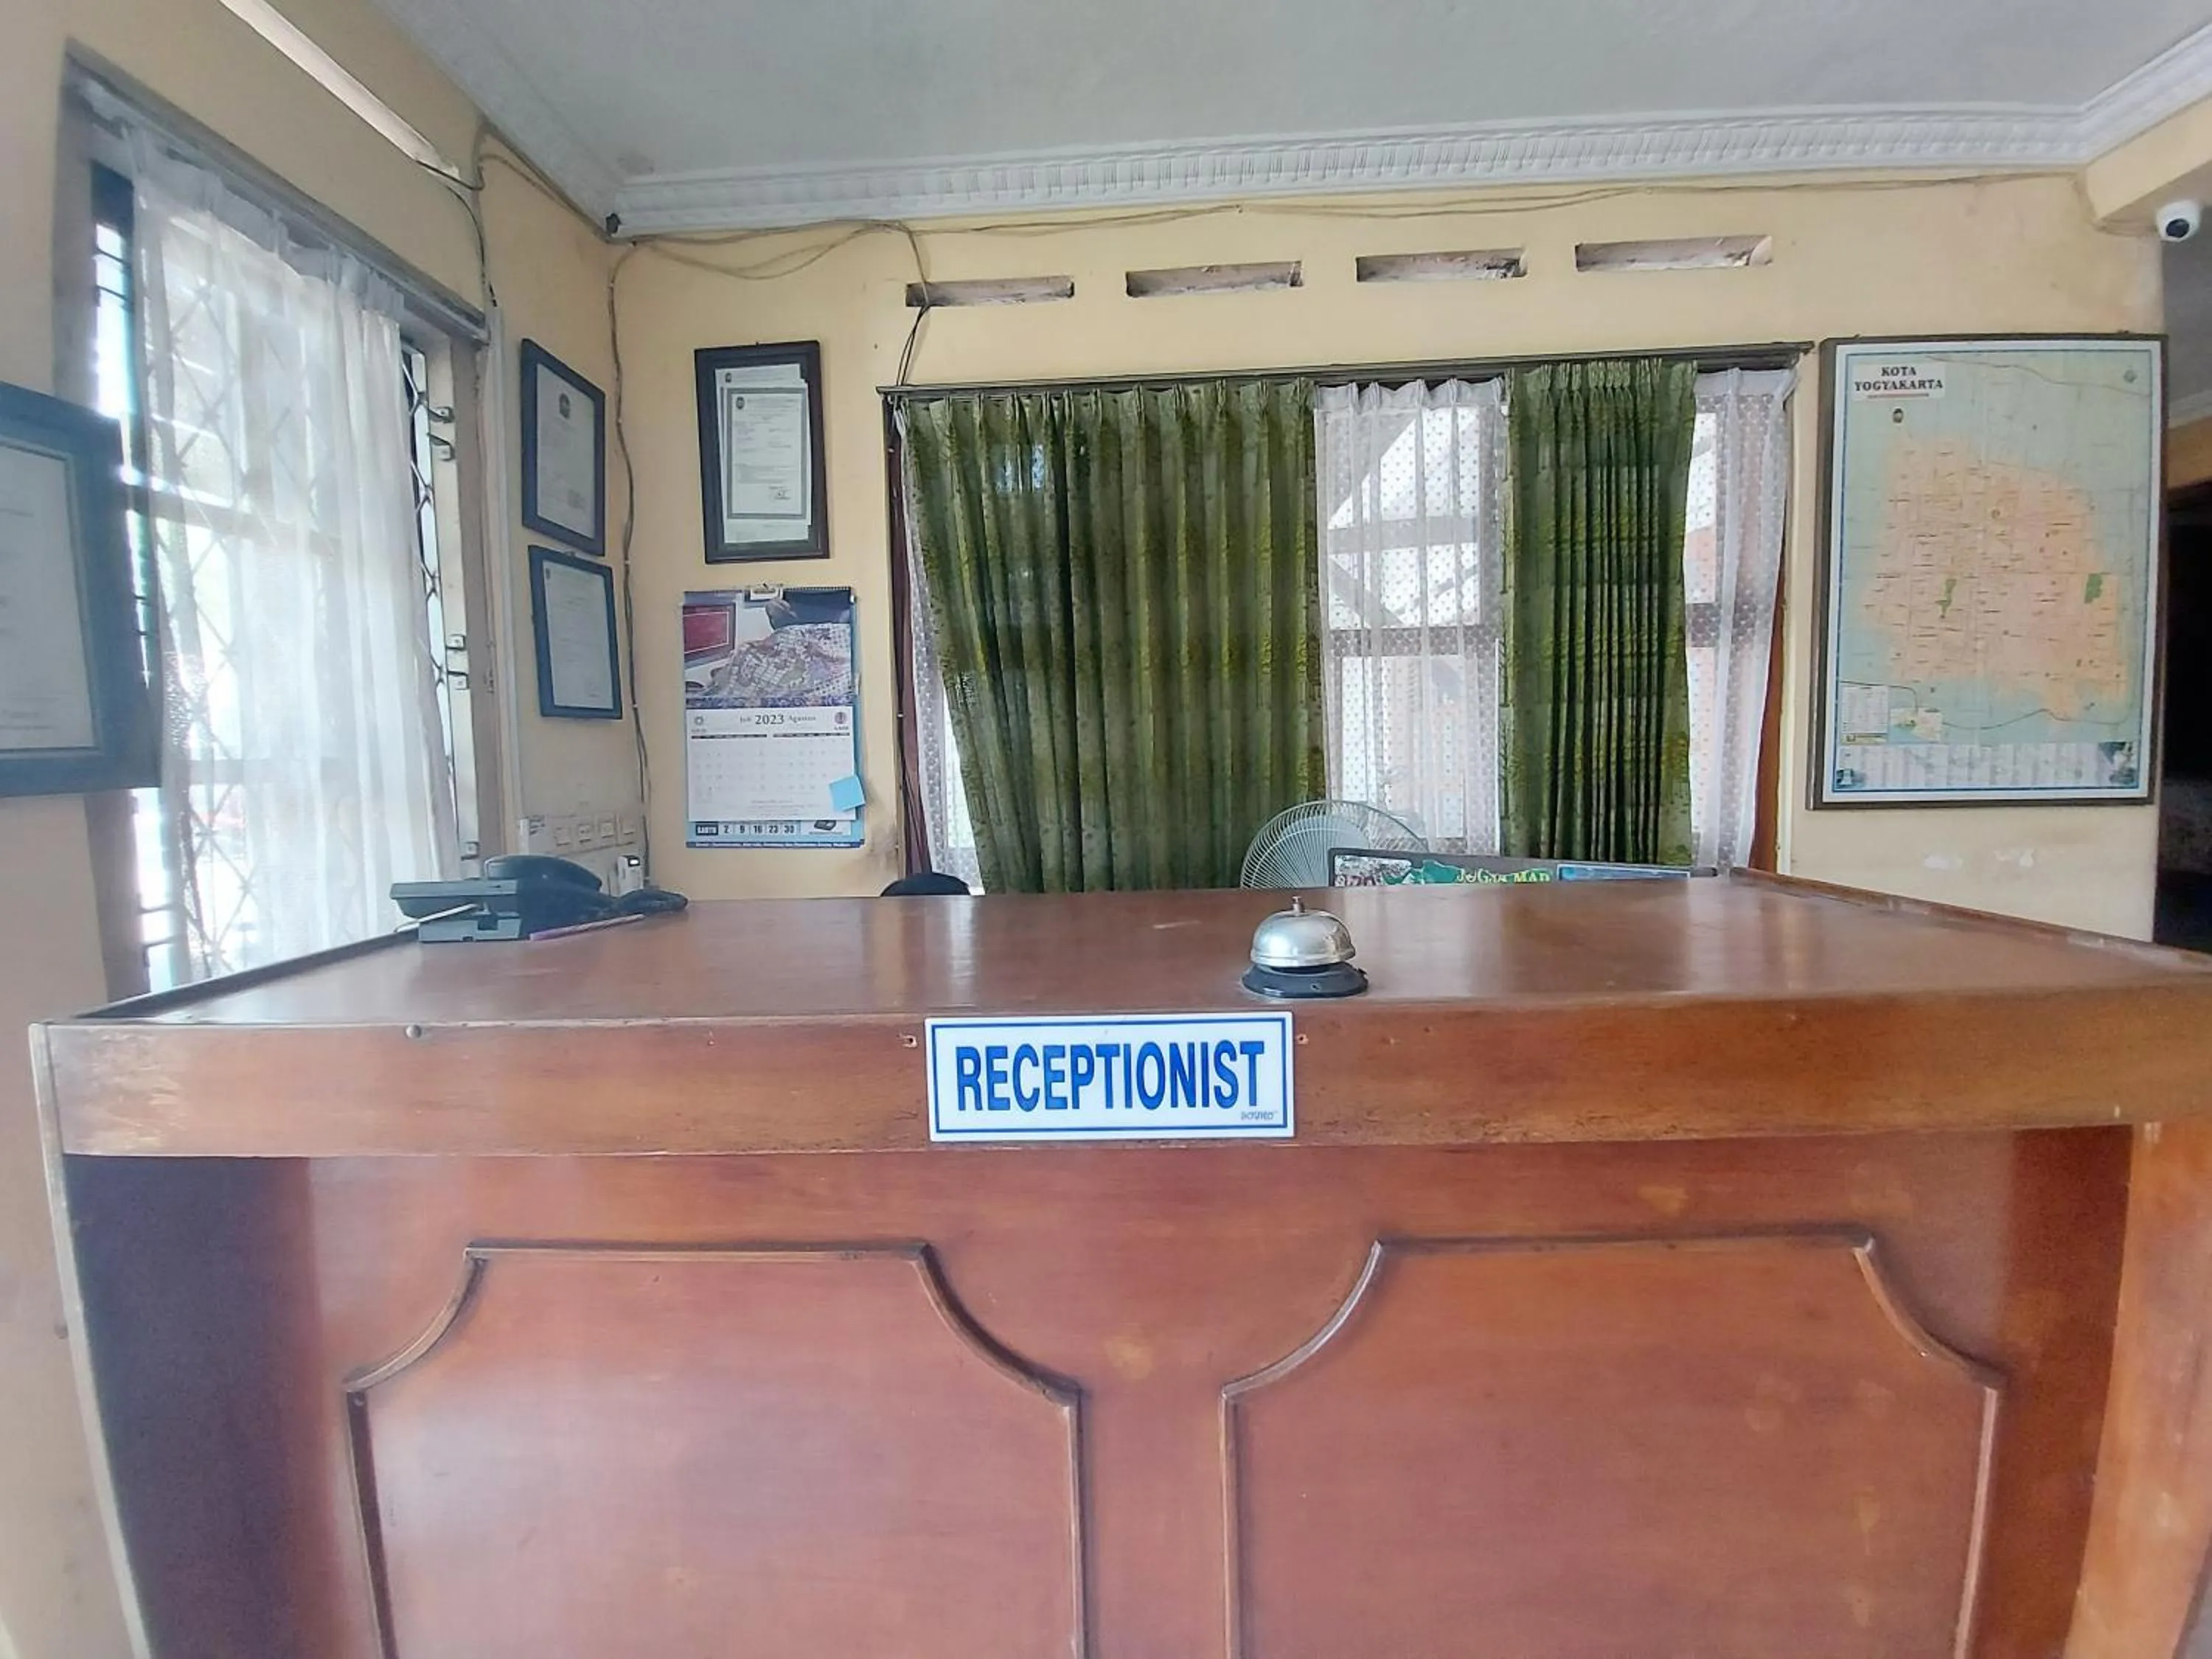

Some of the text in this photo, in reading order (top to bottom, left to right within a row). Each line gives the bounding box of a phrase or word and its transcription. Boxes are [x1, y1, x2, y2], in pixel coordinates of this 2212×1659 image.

[1881, 366, 1916, 377] KOTA
[1854, 379, 1944, 392] YOGYAKARTA
[754, 714, 785, 725] 2023
[723, 824, 730, 834] 2
[768, 824, 779, 834] 23
[955, 1039, 1265, 1111] RECEPTIONIST
